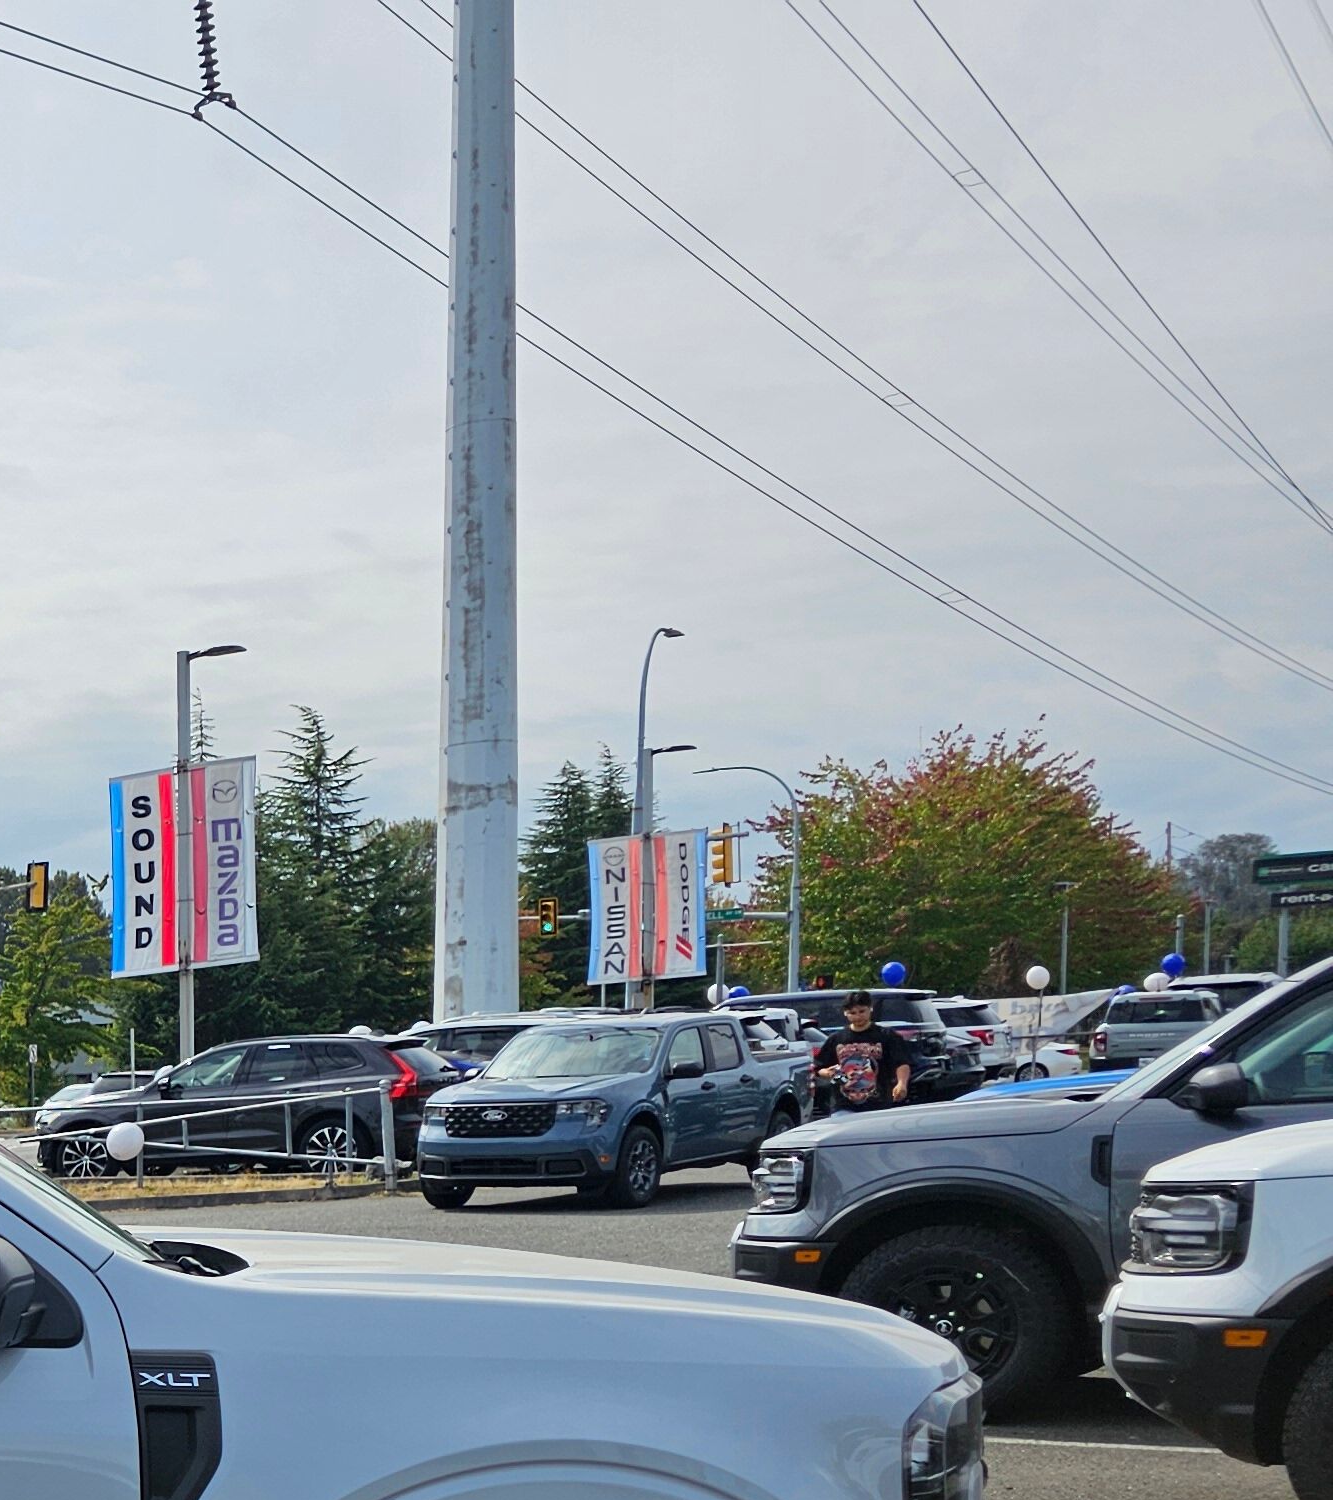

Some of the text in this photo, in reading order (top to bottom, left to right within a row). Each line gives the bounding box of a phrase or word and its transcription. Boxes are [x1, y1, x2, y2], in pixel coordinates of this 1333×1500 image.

[131, 795, 156, 949] SOUND
[604, 867, 626, 975] NISSAN
[138, 1372, 212, 1387] XLT
